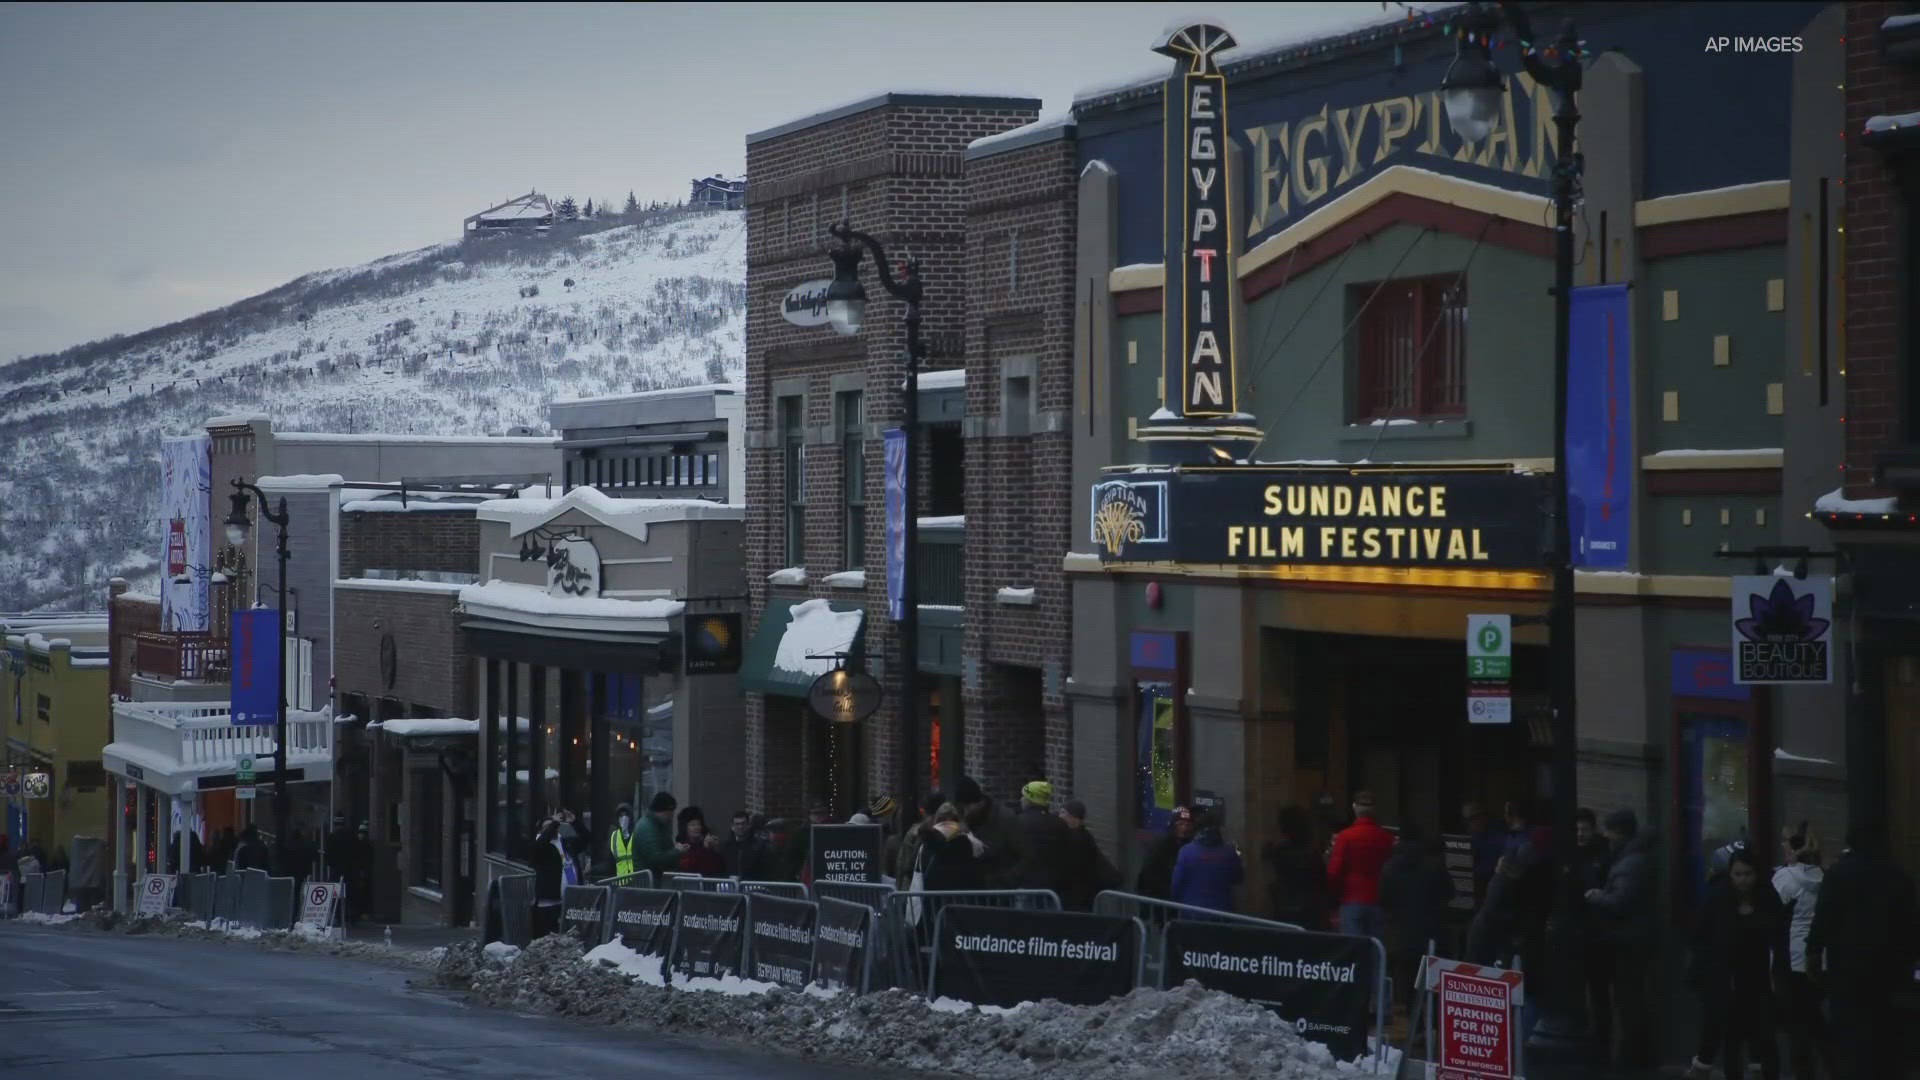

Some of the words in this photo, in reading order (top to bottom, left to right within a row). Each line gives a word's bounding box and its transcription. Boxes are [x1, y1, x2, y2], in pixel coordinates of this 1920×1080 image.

[1244, 71, 1578, 238] EGYPTAN
[1191, 85, 1223, 405] EGYPTIAN
[1263, 485, 1446, 517] SUNDANCE
[1228, 526, 1304, 557] FILM
[1320, 526, 1489, 560] FESTIVAL
[1485, 631, 1497, 648] P
[1743, 643, 1825, 662] BEAUTY
[1474, 659, 1484, 674] 3
[1743, 662, 1824, 678] BOUTIQUE
[824, 850, 868, 859] CAUTION:
[826, 861, 848, 872] WET,
[851, 861, 865, 871] ICY
[825, 873, 867, 882] SURFACE
[955, 934, 1025, 955] sundance
[1028, 937, 1058, 958] film
[1060, 938, 1117, 962] festival
[1182, 950, 1259, 973] sundance
[1261, 955, 1293, 977] film
[1296, 958, 1356, 983] festival
[1447, 980, 1504, 997] SUNDANCE
[1447, 991, 1466, 1002] FILM
[1467, 994, 1503, 1008] FESTIVAL
[1447, 1006, 1503, 1023] PARKING
[1453, 1019, 1478, 1032] FOR
[1481, 1024, 1499, 1036] (N)
[1453, 1031, 1499, 1047] PERMIT
[1460, 1045, 1493, 1058] ONLY
[1450, 1058, 1465, 1066] TOW
[1467, 1060, 1504, 1072] ENFORCED
